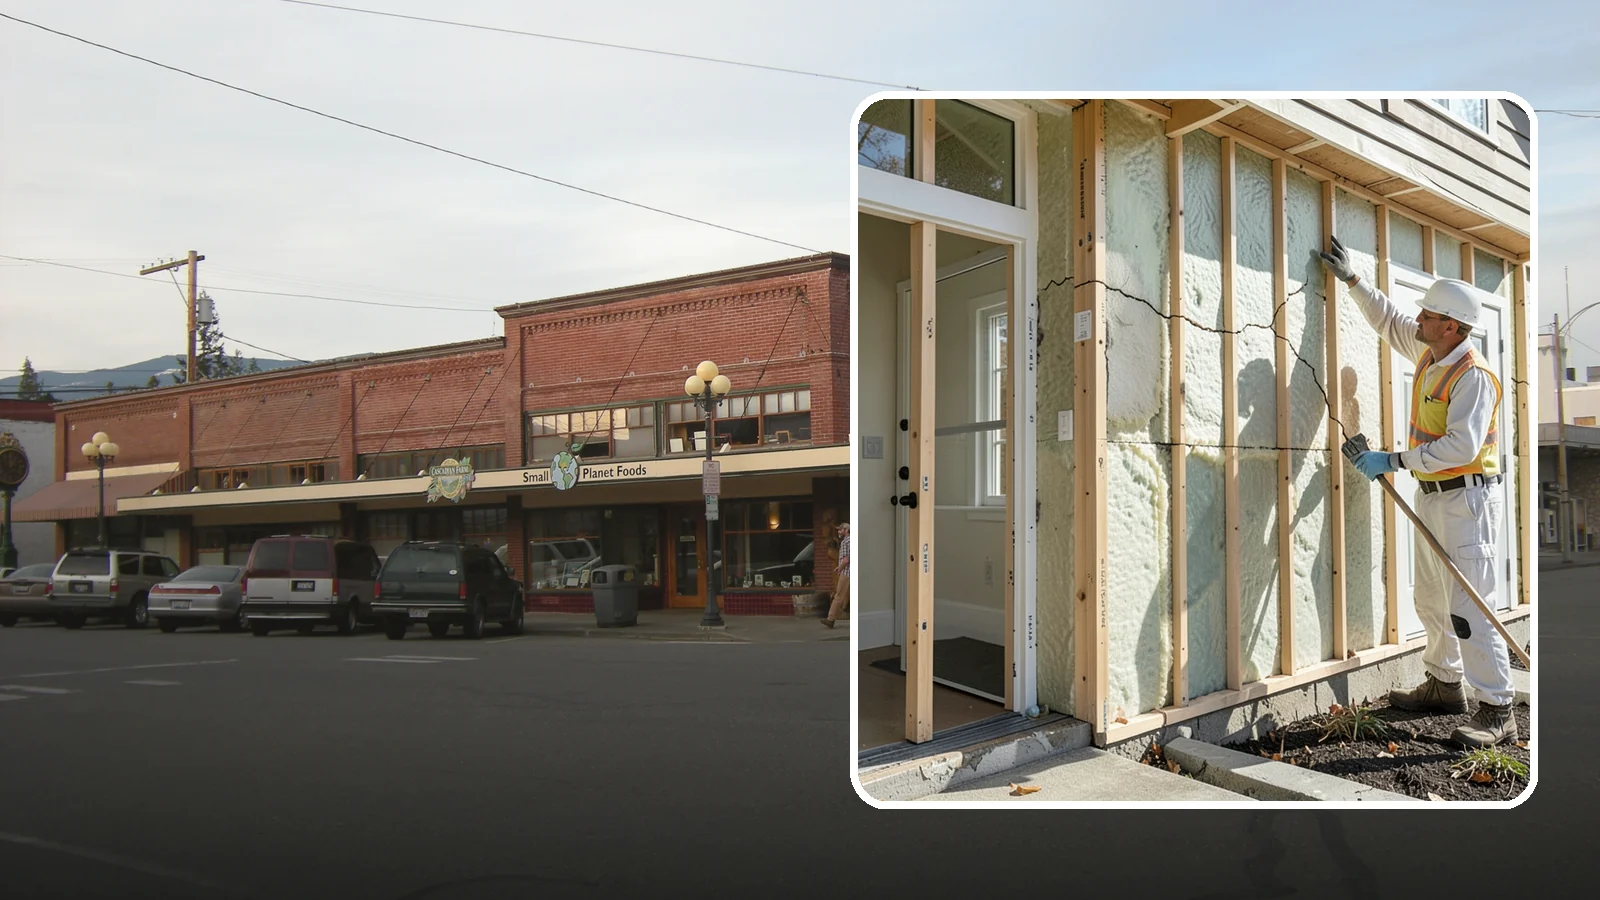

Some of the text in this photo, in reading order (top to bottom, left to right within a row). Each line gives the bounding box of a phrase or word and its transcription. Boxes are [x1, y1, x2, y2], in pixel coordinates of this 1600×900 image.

[523, 464, 647, 483] Small Planet Foods
